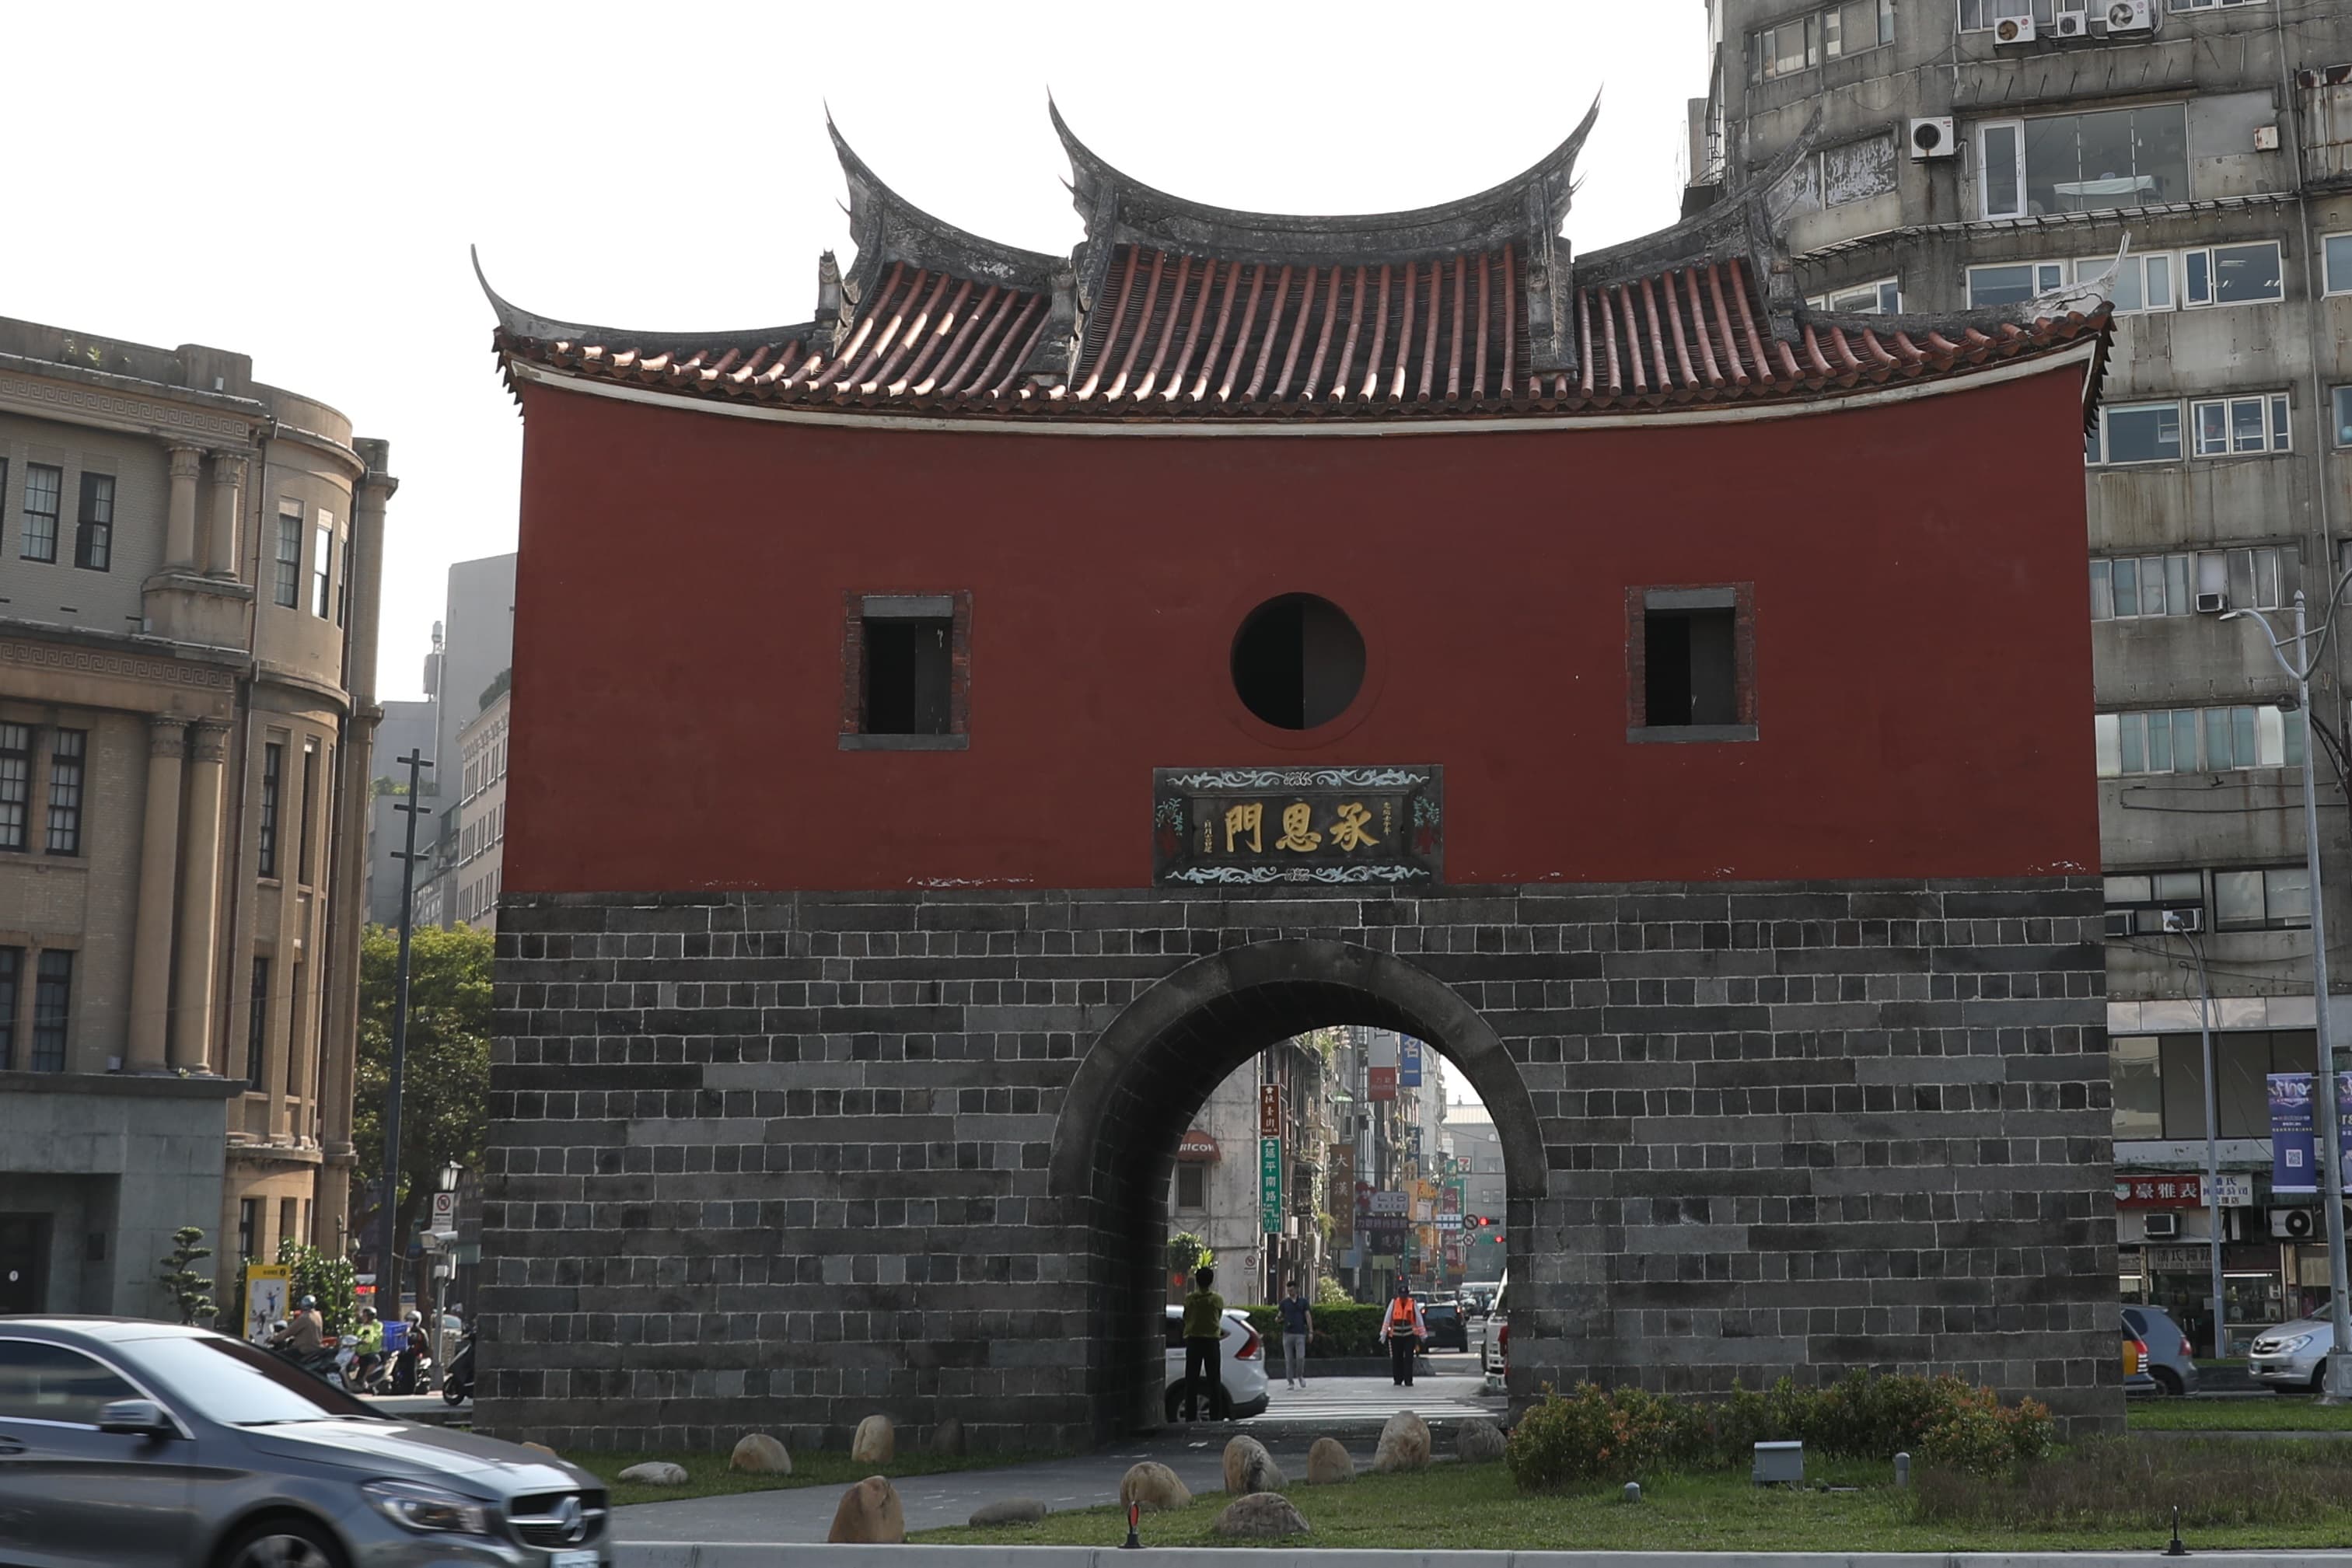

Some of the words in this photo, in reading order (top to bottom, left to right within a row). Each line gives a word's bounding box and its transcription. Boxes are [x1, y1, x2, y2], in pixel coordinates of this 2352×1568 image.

[1225, 801, 1380, 853] 承恩門
[1265, 1148, 1276, 1202] 延平南路
[2136, 1182, 2197, 1200] 豪雅表
